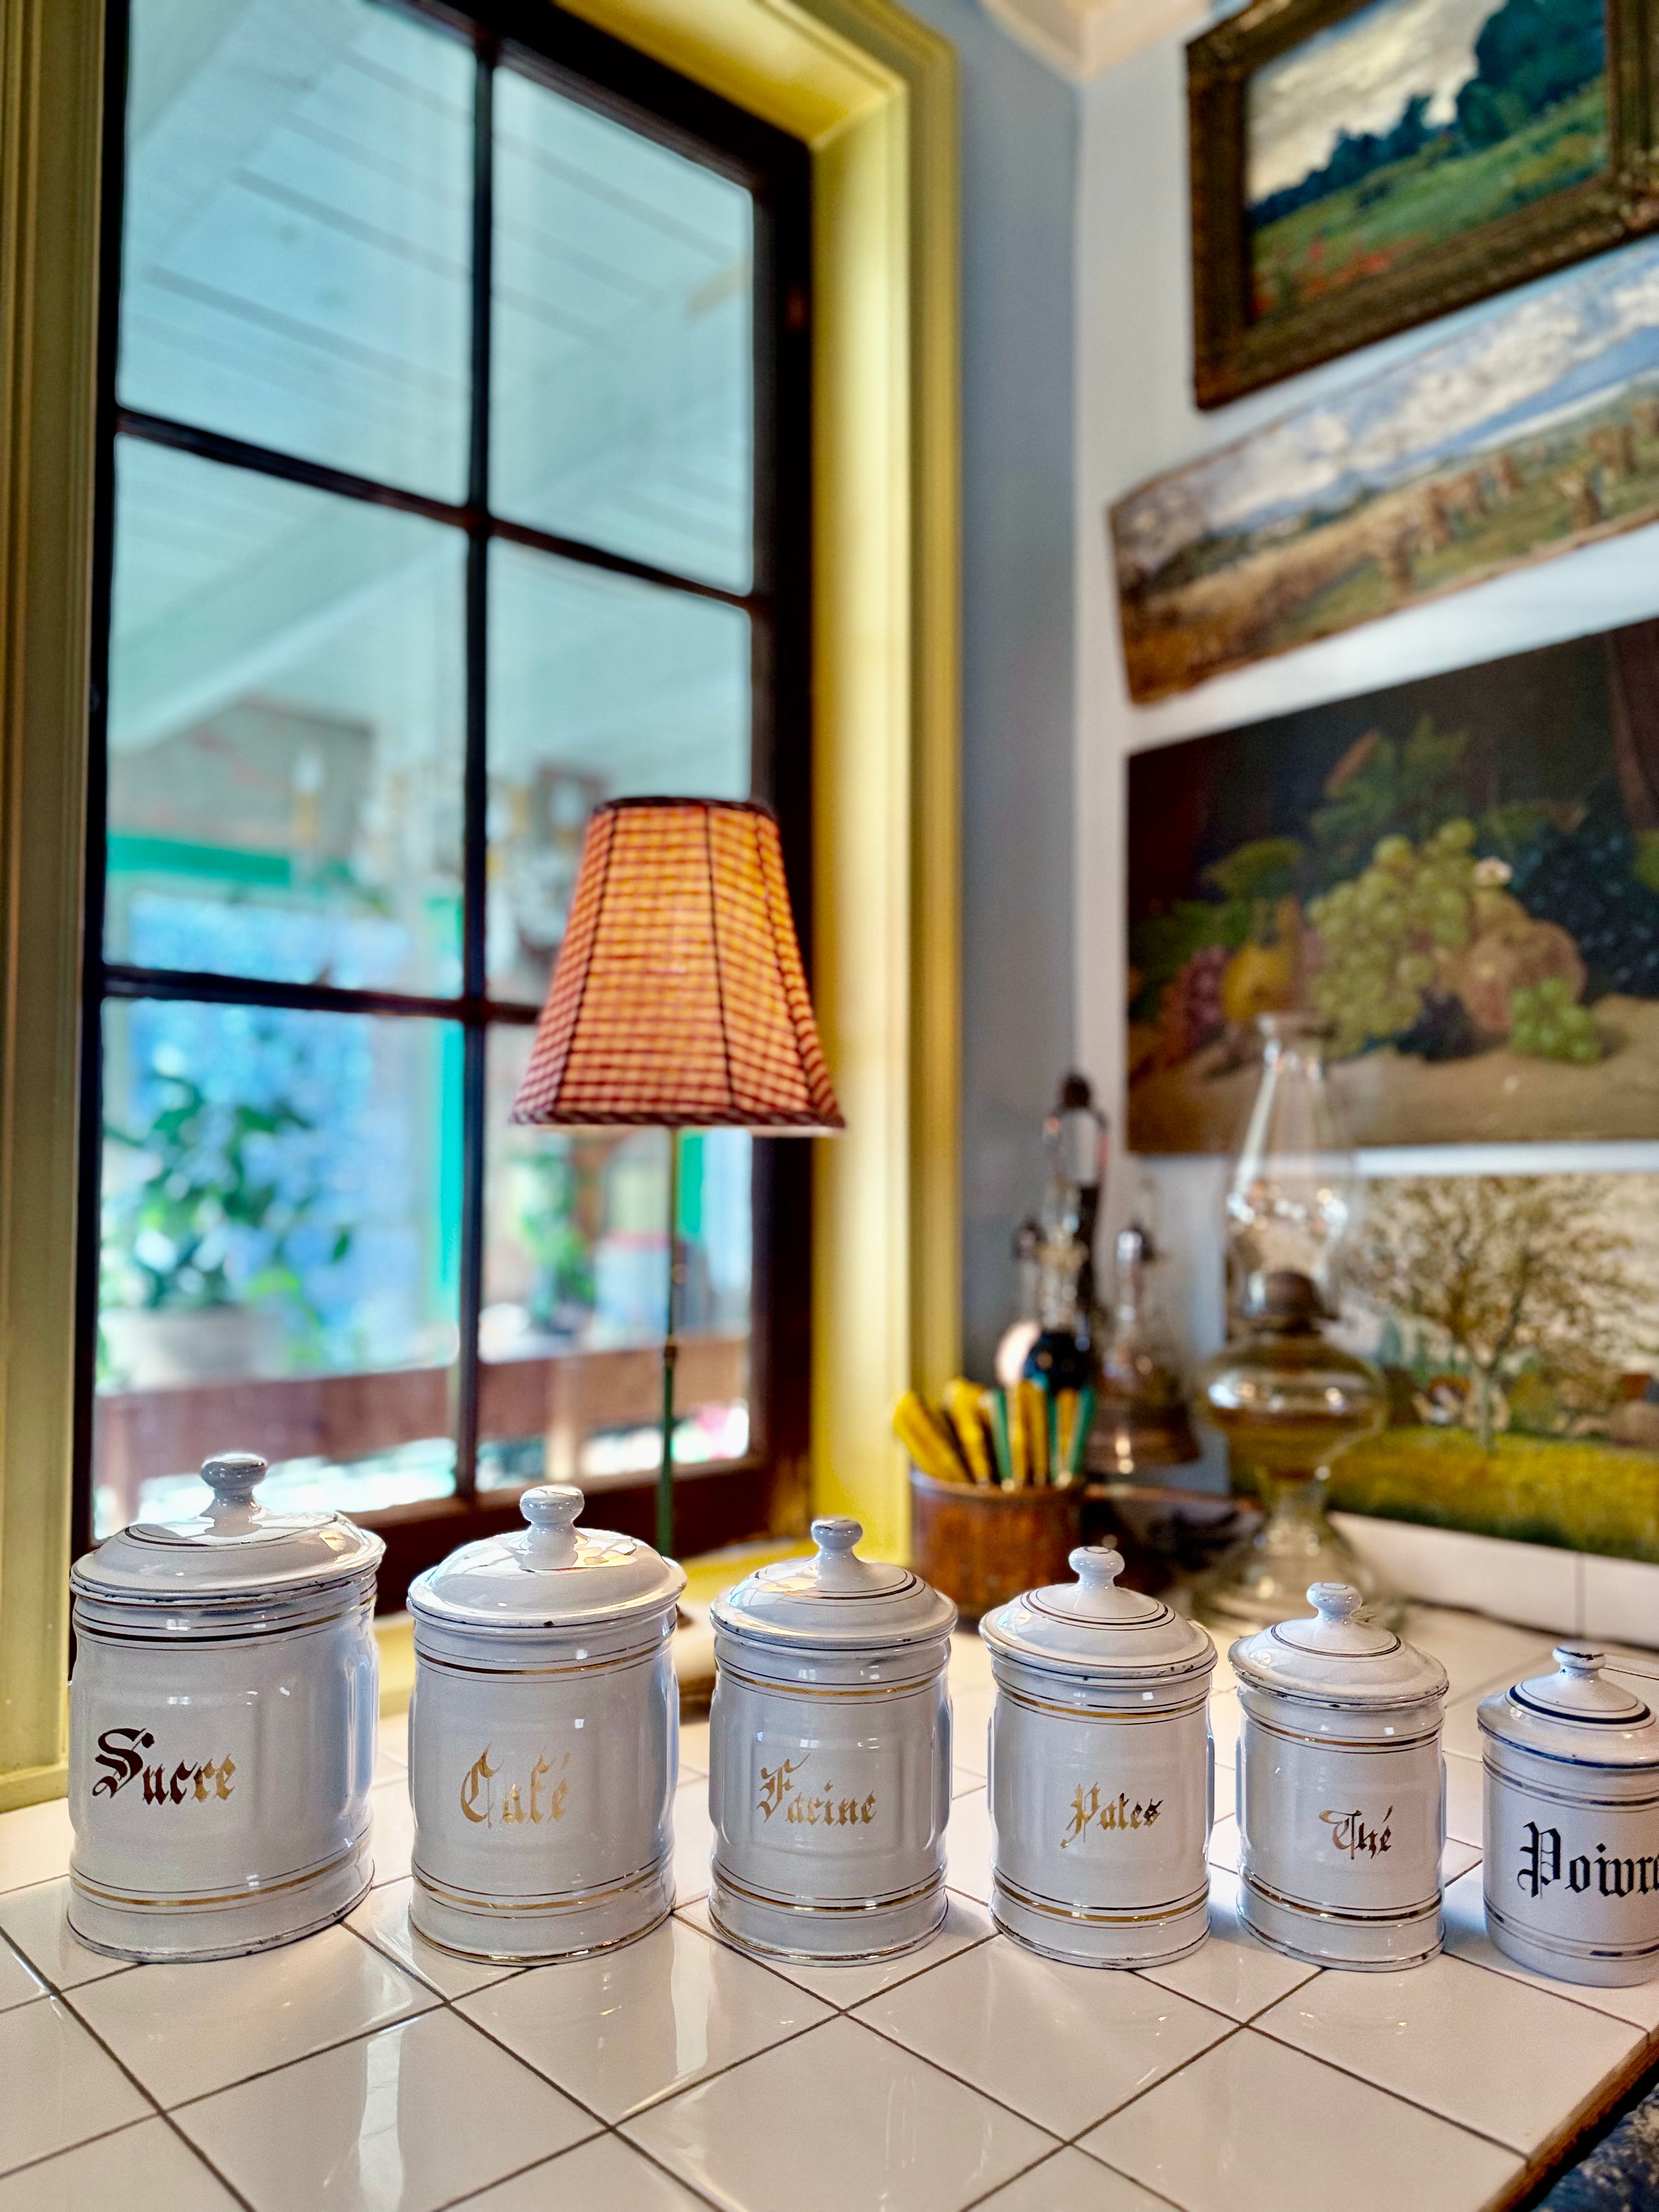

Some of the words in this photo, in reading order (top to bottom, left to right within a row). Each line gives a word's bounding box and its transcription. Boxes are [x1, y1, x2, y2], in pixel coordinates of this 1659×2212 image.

[92, 1728, 236, 1805] Sucre
[460, 1741, 571, 1829] Café
[757, 1752, 876, 1826] Farine
[1318, 1804, 1393, 1860] Thé
